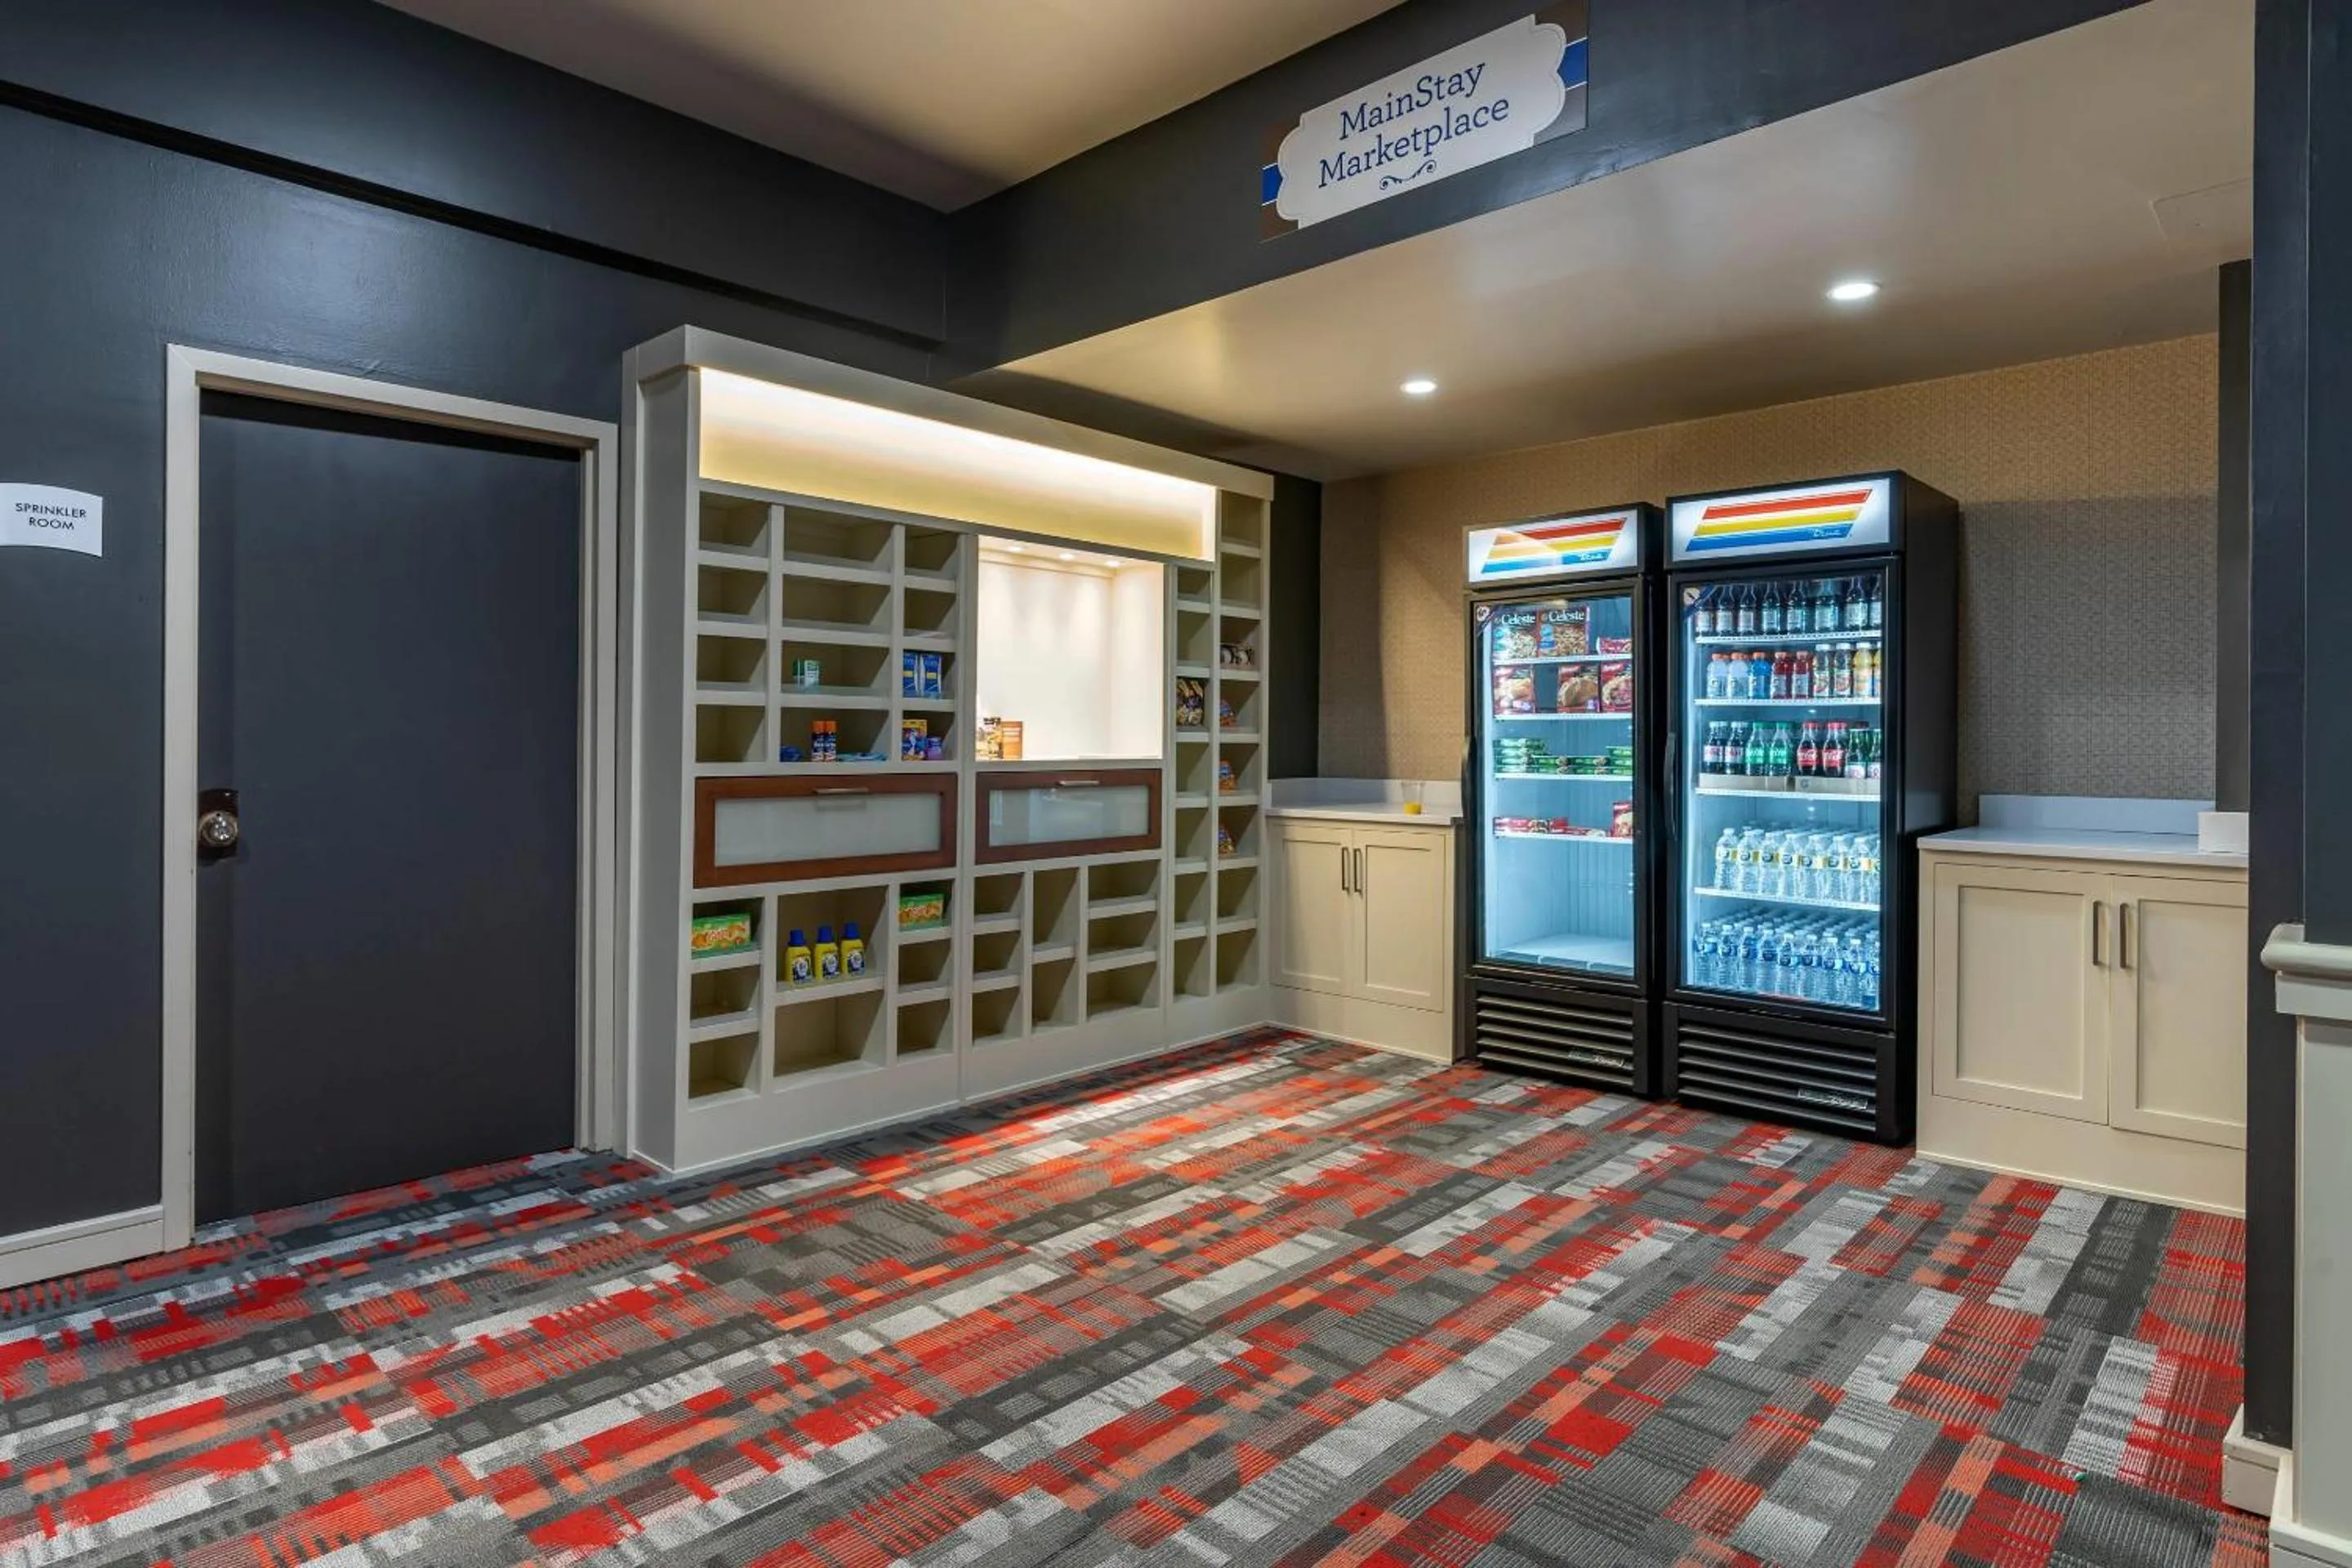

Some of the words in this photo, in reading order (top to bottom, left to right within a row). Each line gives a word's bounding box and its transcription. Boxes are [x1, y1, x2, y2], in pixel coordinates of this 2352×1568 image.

[1339, 63, 1486, 140] MainStay
[1317, 98, 1509, 188] Marketplace
[16, 502, 87, 518] SPRINKLER
[29, 516, 74, 530] ROOM
[1501, 613, 1536, 625] Celeste
[1548, 610, 1584, 622] Celeste
